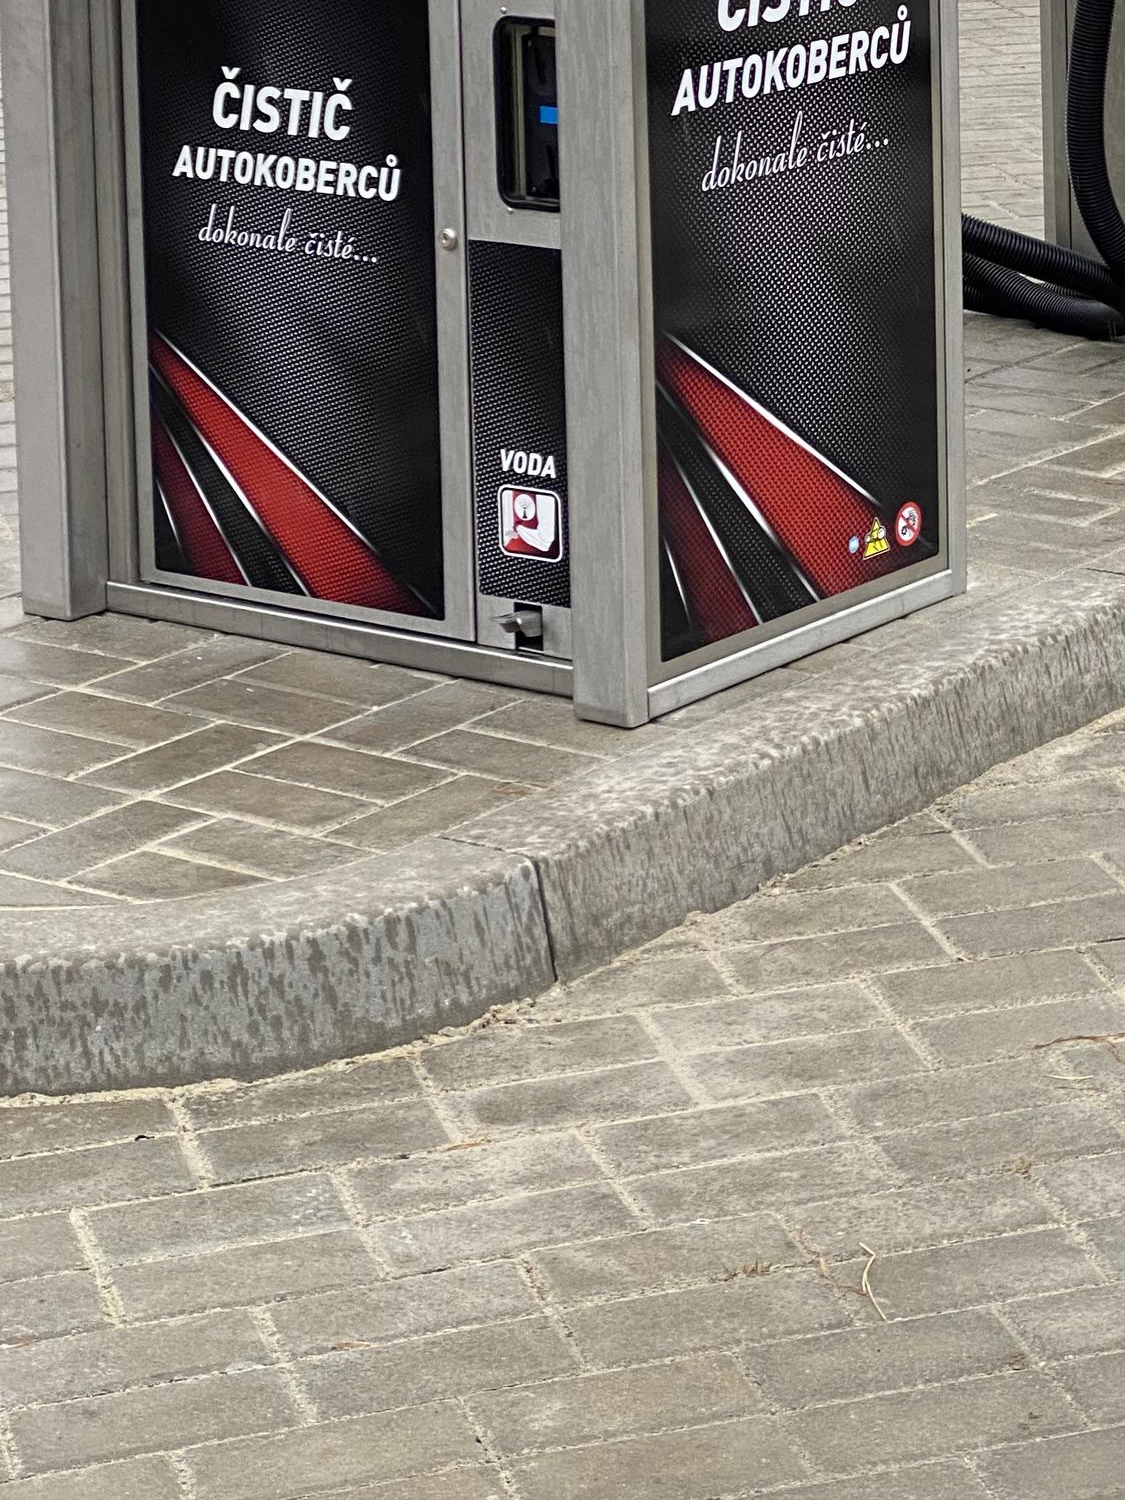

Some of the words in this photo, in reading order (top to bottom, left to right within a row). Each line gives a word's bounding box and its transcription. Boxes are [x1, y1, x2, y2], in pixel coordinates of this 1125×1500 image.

[671, 4, 911, 117] AUTOKOBERCŮ
[212, 65, 353, 141] ČISTIČ
[172, 145, 401, 202] AUTOKOBERCŮ
[701, 110, 808, 192] dokonale
[198, 203, 297, 251] dokonale
[500, 449, 557, 479] VODA
